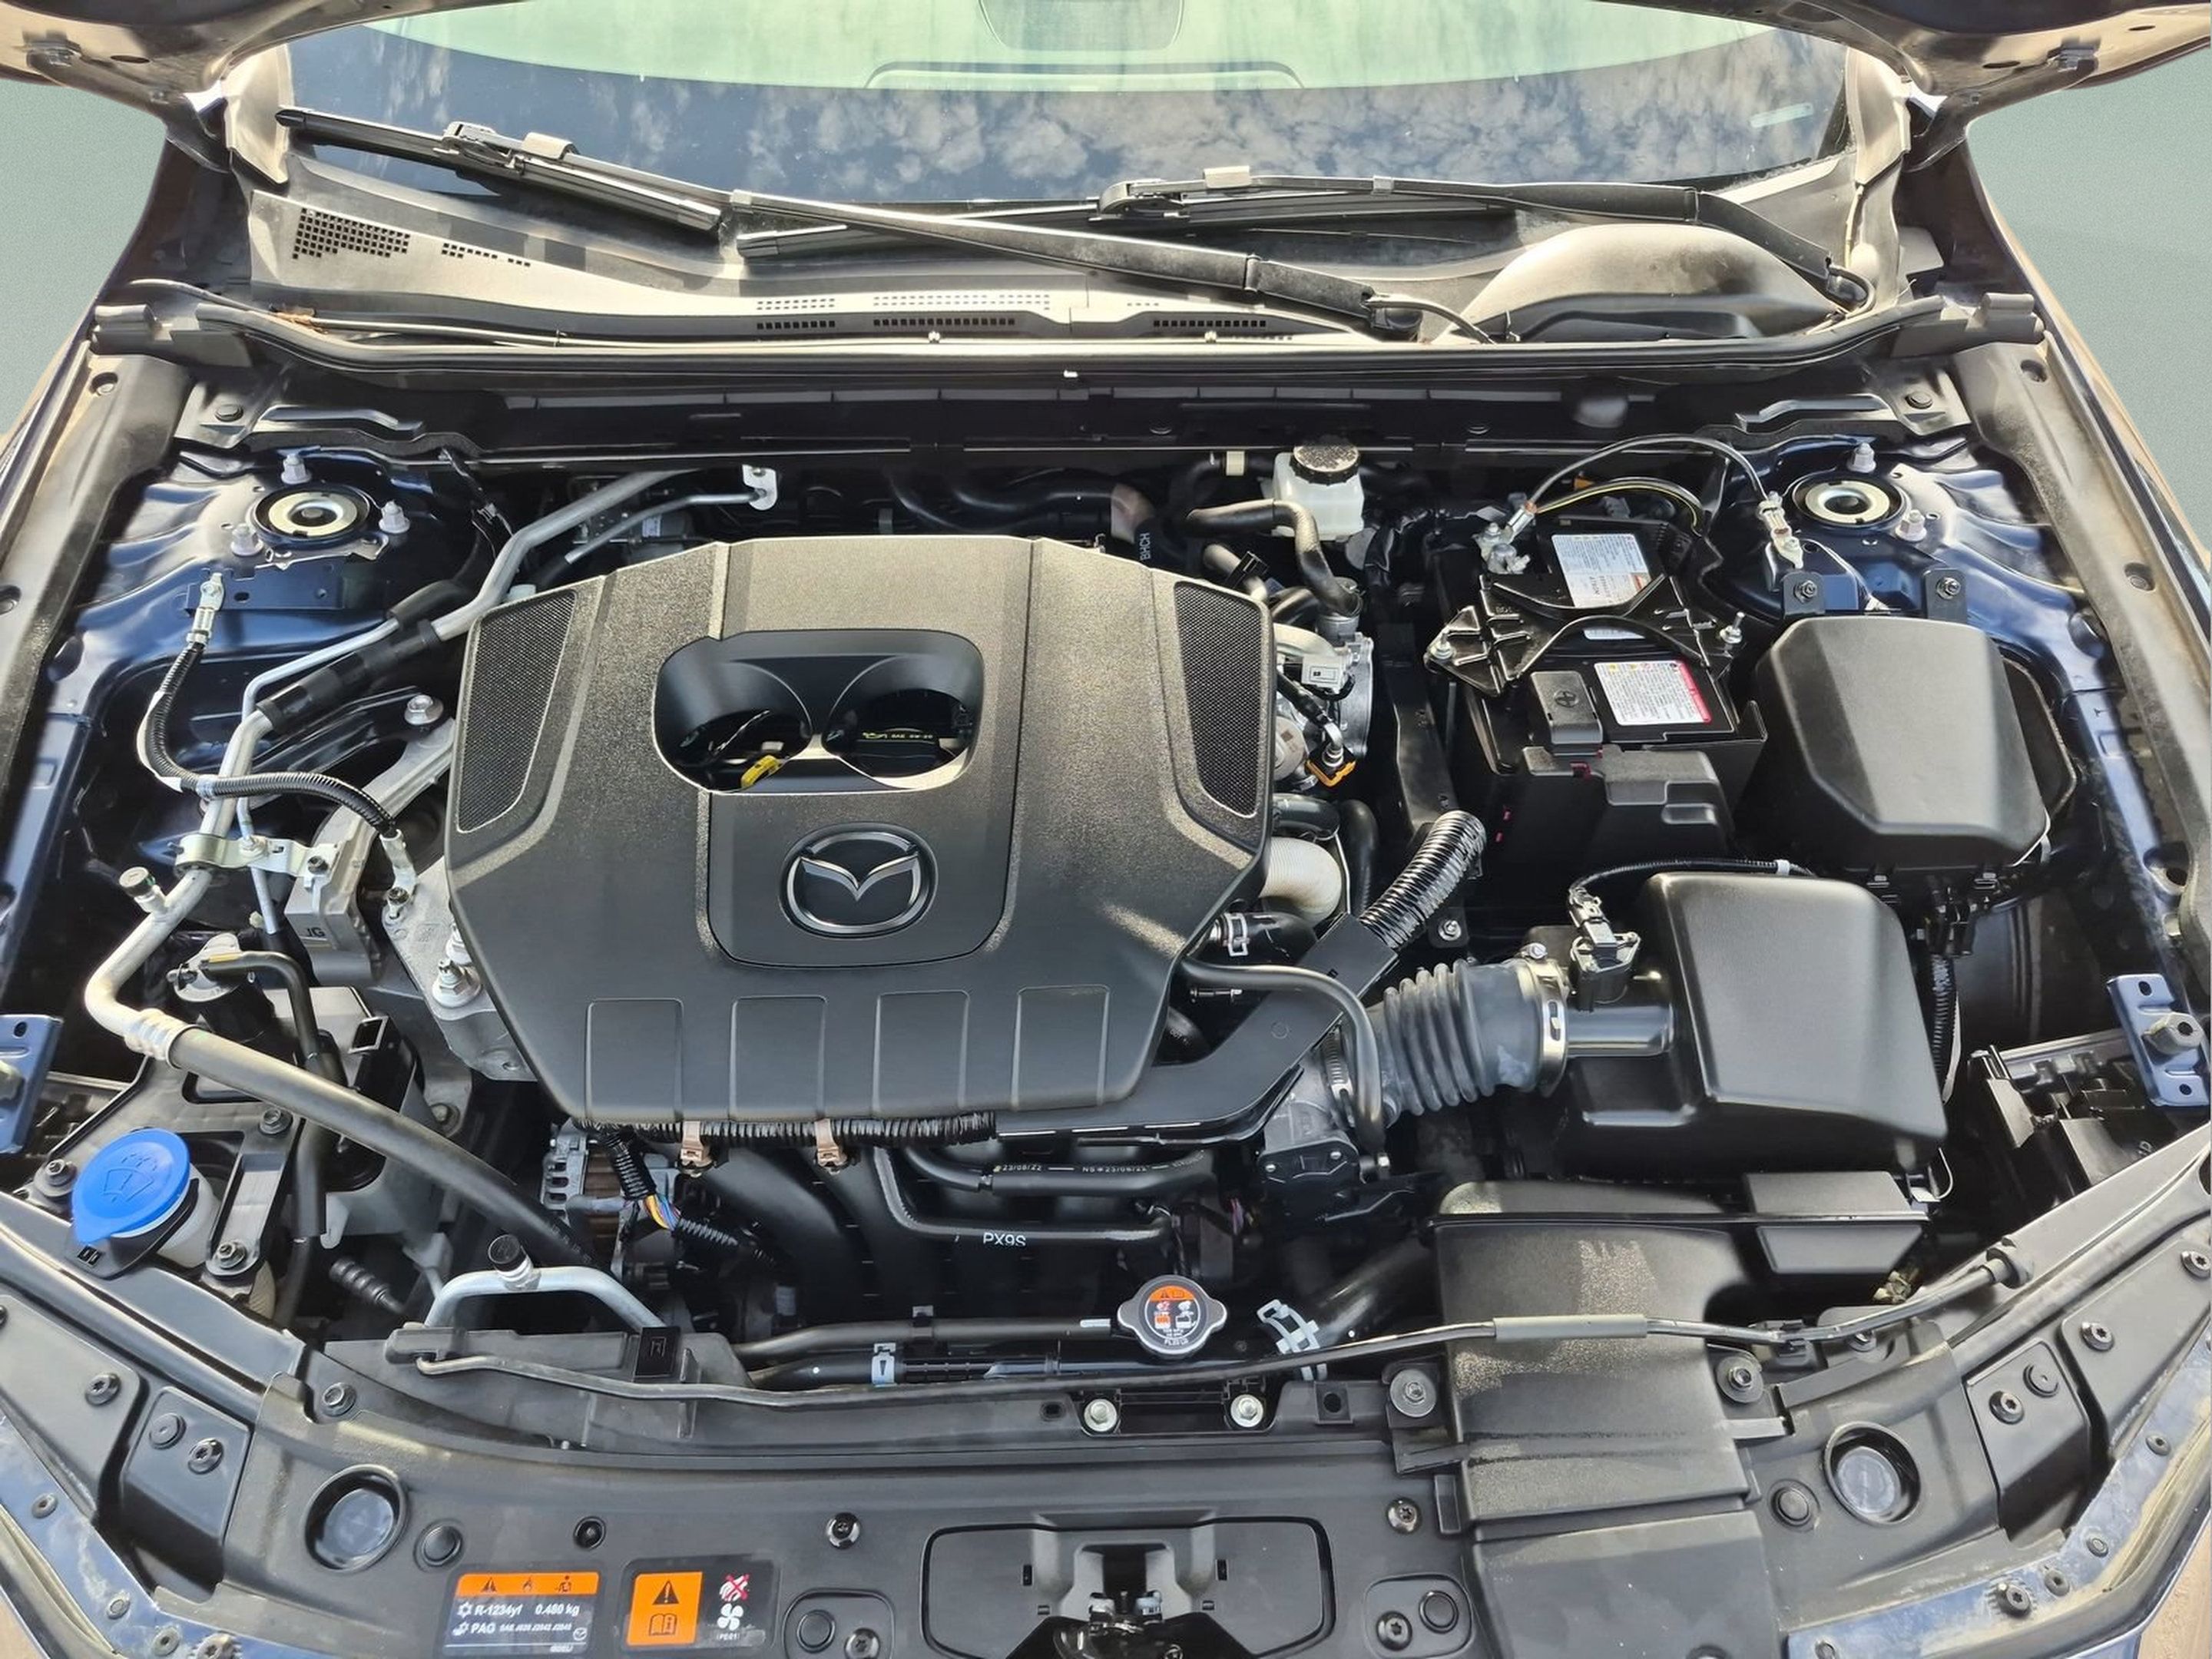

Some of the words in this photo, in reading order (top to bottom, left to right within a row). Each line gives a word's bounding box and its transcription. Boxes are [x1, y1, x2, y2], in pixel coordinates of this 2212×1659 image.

[1139, 532, 1151, 561] BHCH
[982, 1231, 1027, 1247] PX9S
[565, 1604, 581, 1617] kg
